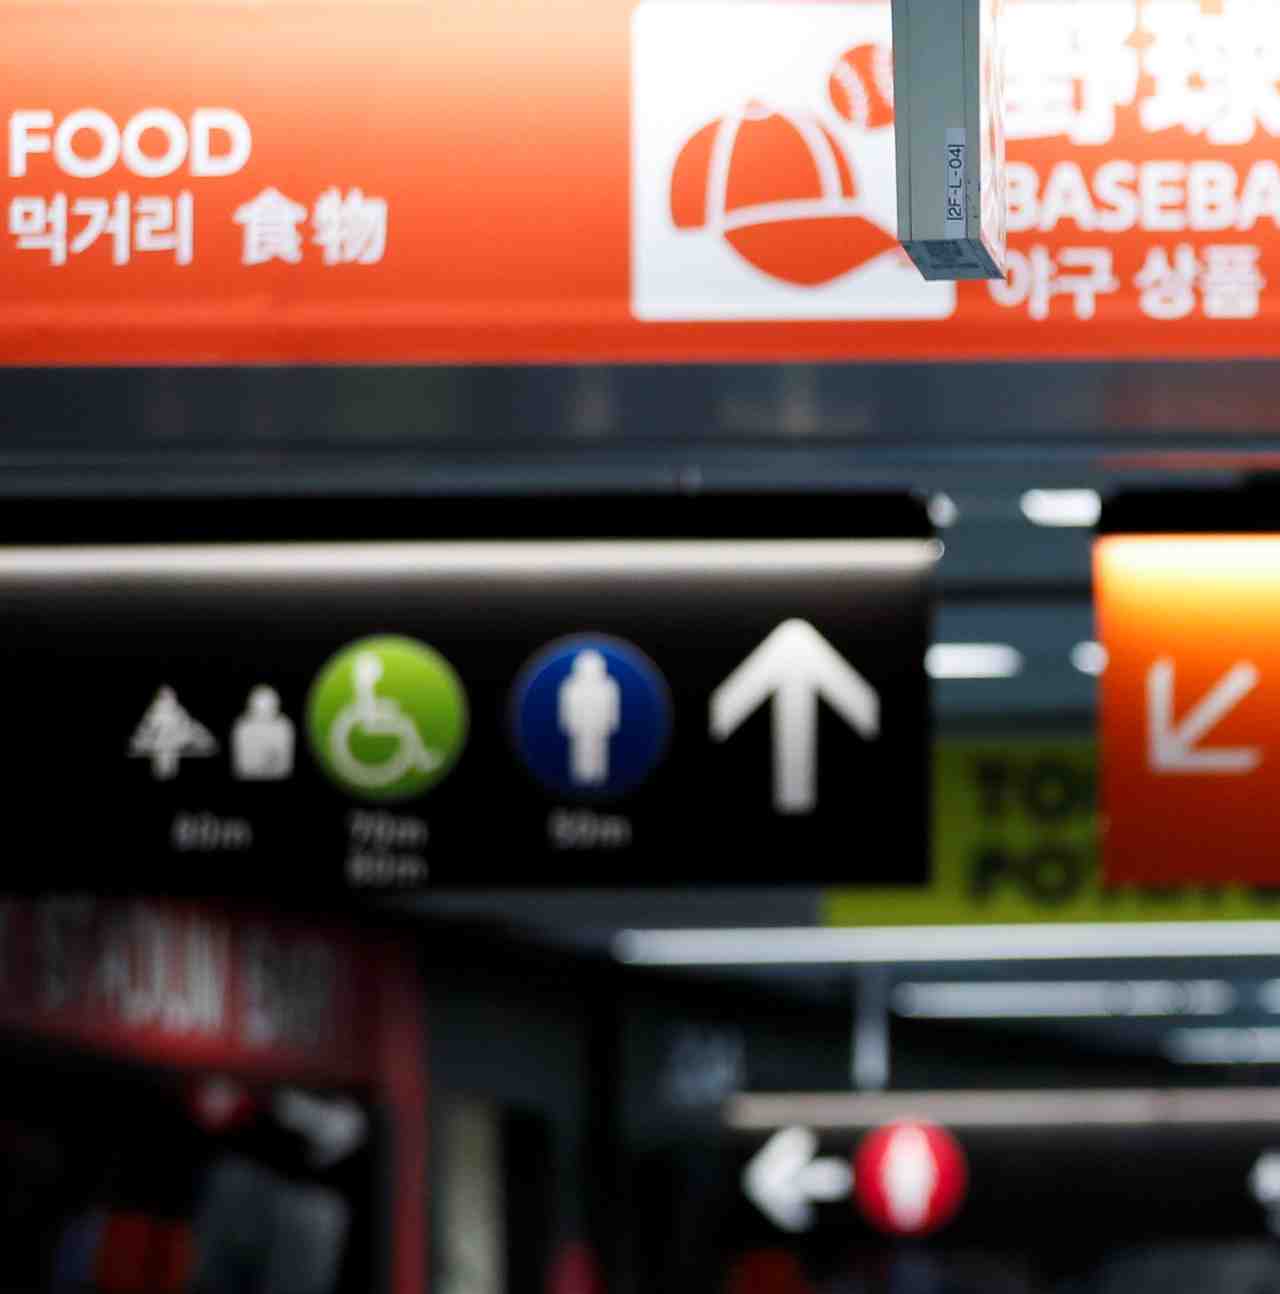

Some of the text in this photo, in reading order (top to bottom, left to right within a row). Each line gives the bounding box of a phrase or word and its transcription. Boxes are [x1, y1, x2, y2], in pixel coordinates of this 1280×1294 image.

[8, 107, 253, 178] FOOD
[7, 190, 195, 267] 먹거리
[232, 186, 391, 267] 食物
[987, 243, 1264, 321] 야구 상품
